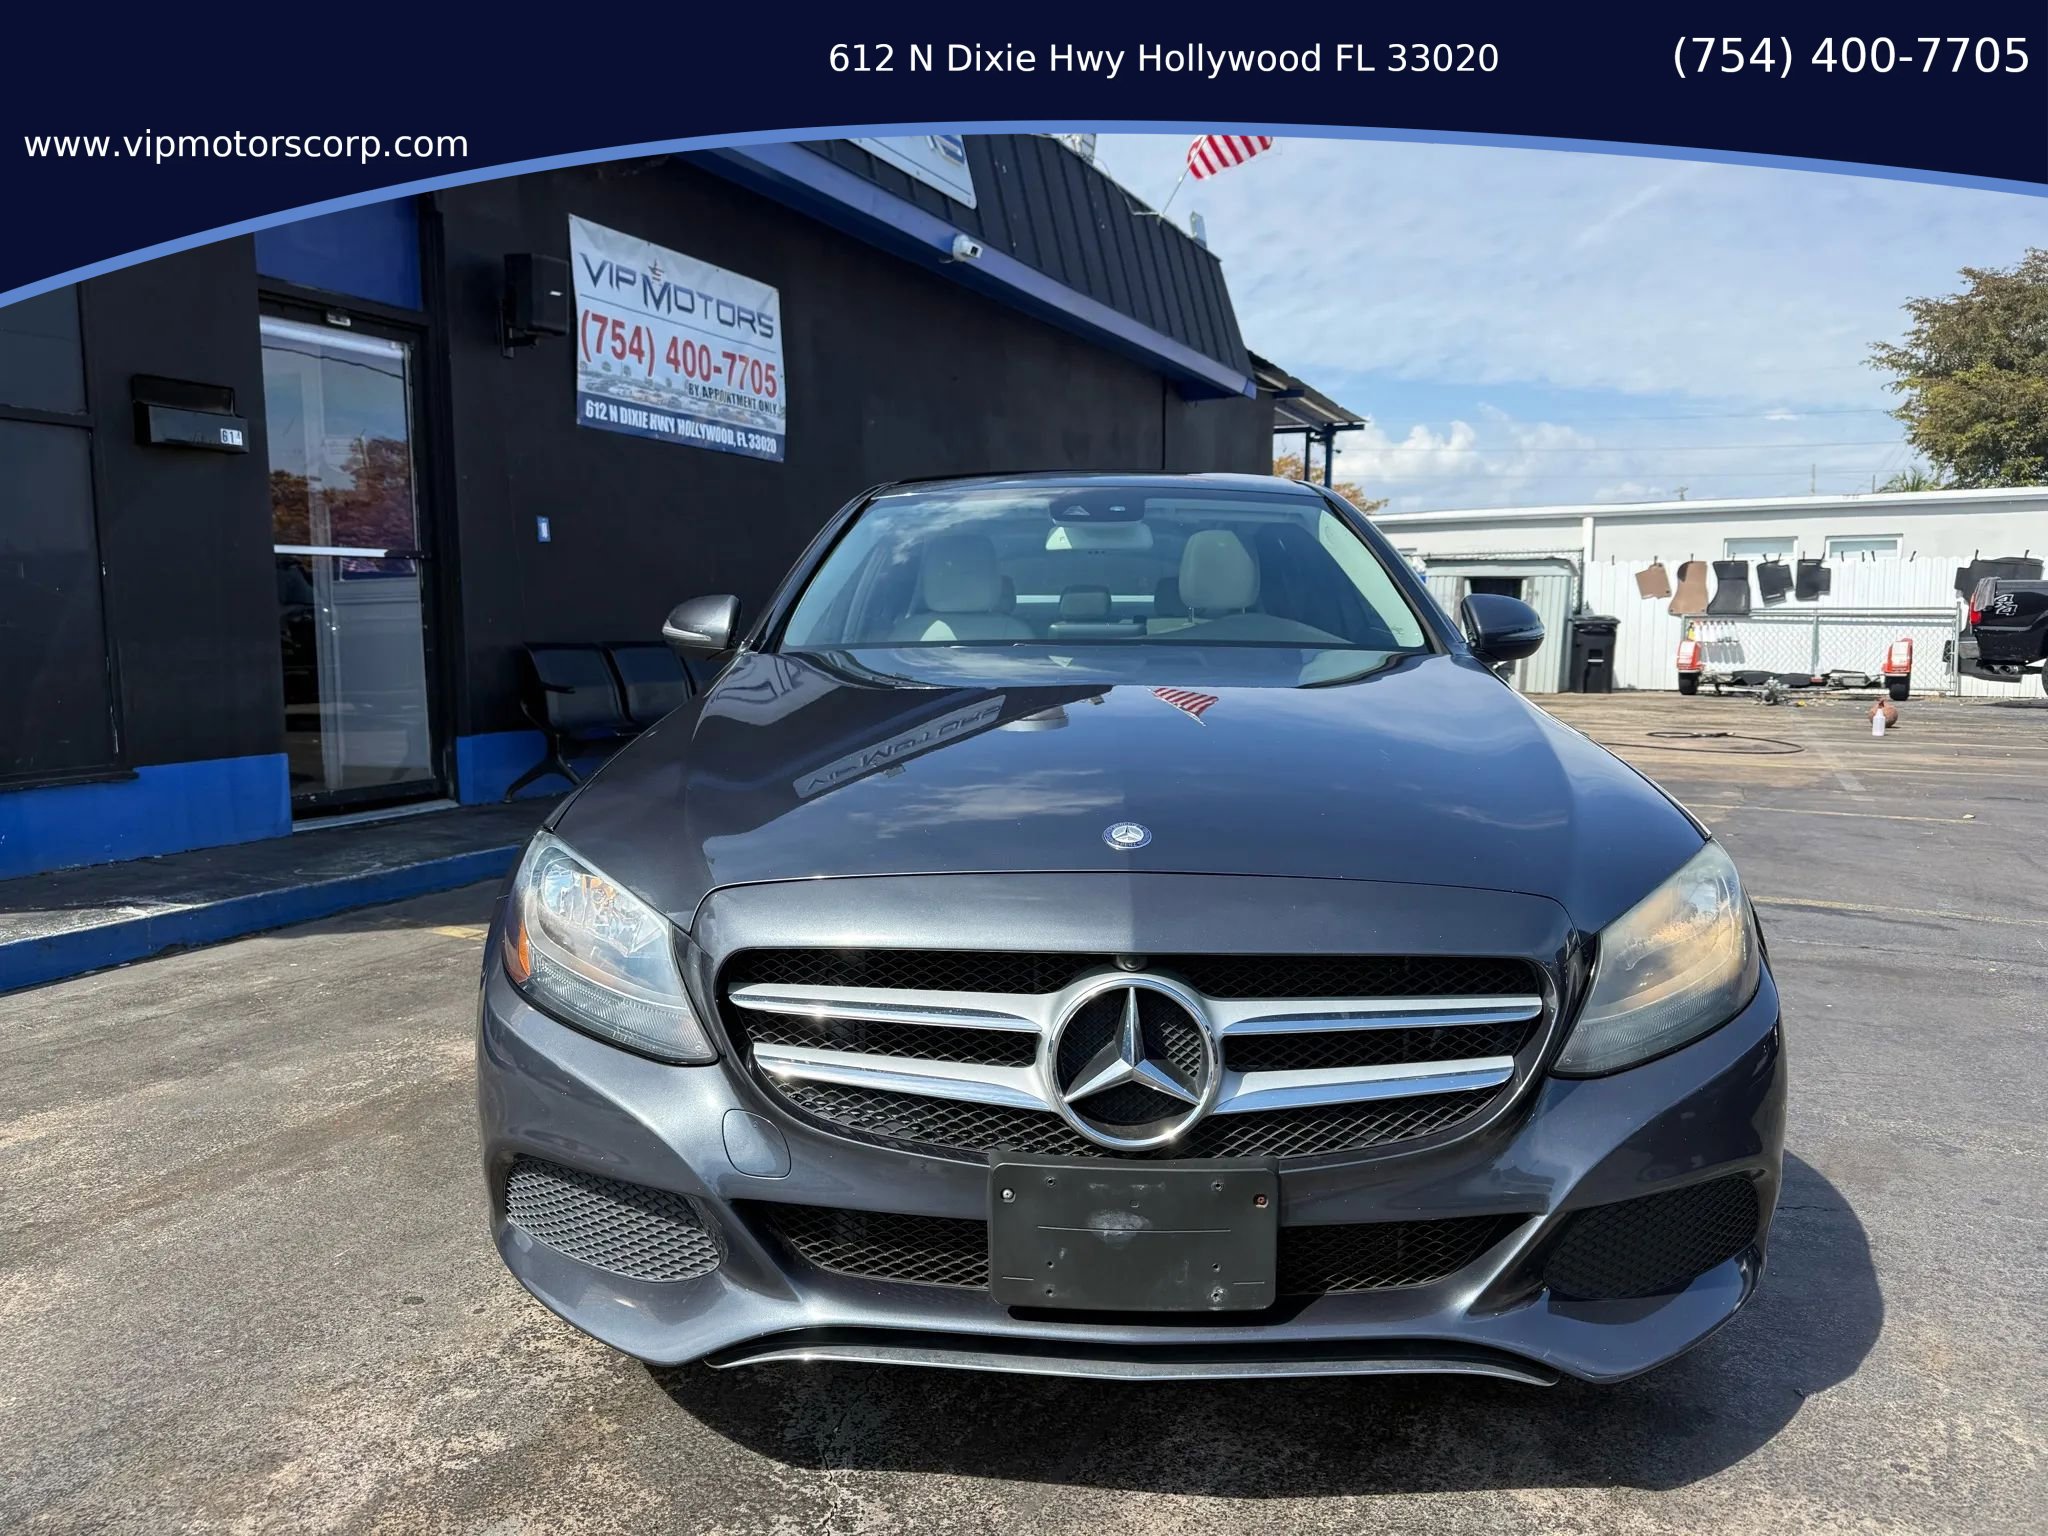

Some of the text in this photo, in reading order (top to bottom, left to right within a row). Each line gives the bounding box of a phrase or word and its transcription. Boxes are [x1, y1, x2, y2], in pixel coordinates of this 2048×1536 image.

[580, 252, 773, 339] VIP MOTORS
[581, 309, 777, 398] (754) 400-7705
[585, 399, 777, 454] 612 N DIXIE HWY HOLLYWOOD, FL 33020
[688, 383, 778, 414] BY APPOINTMENT ONLY
